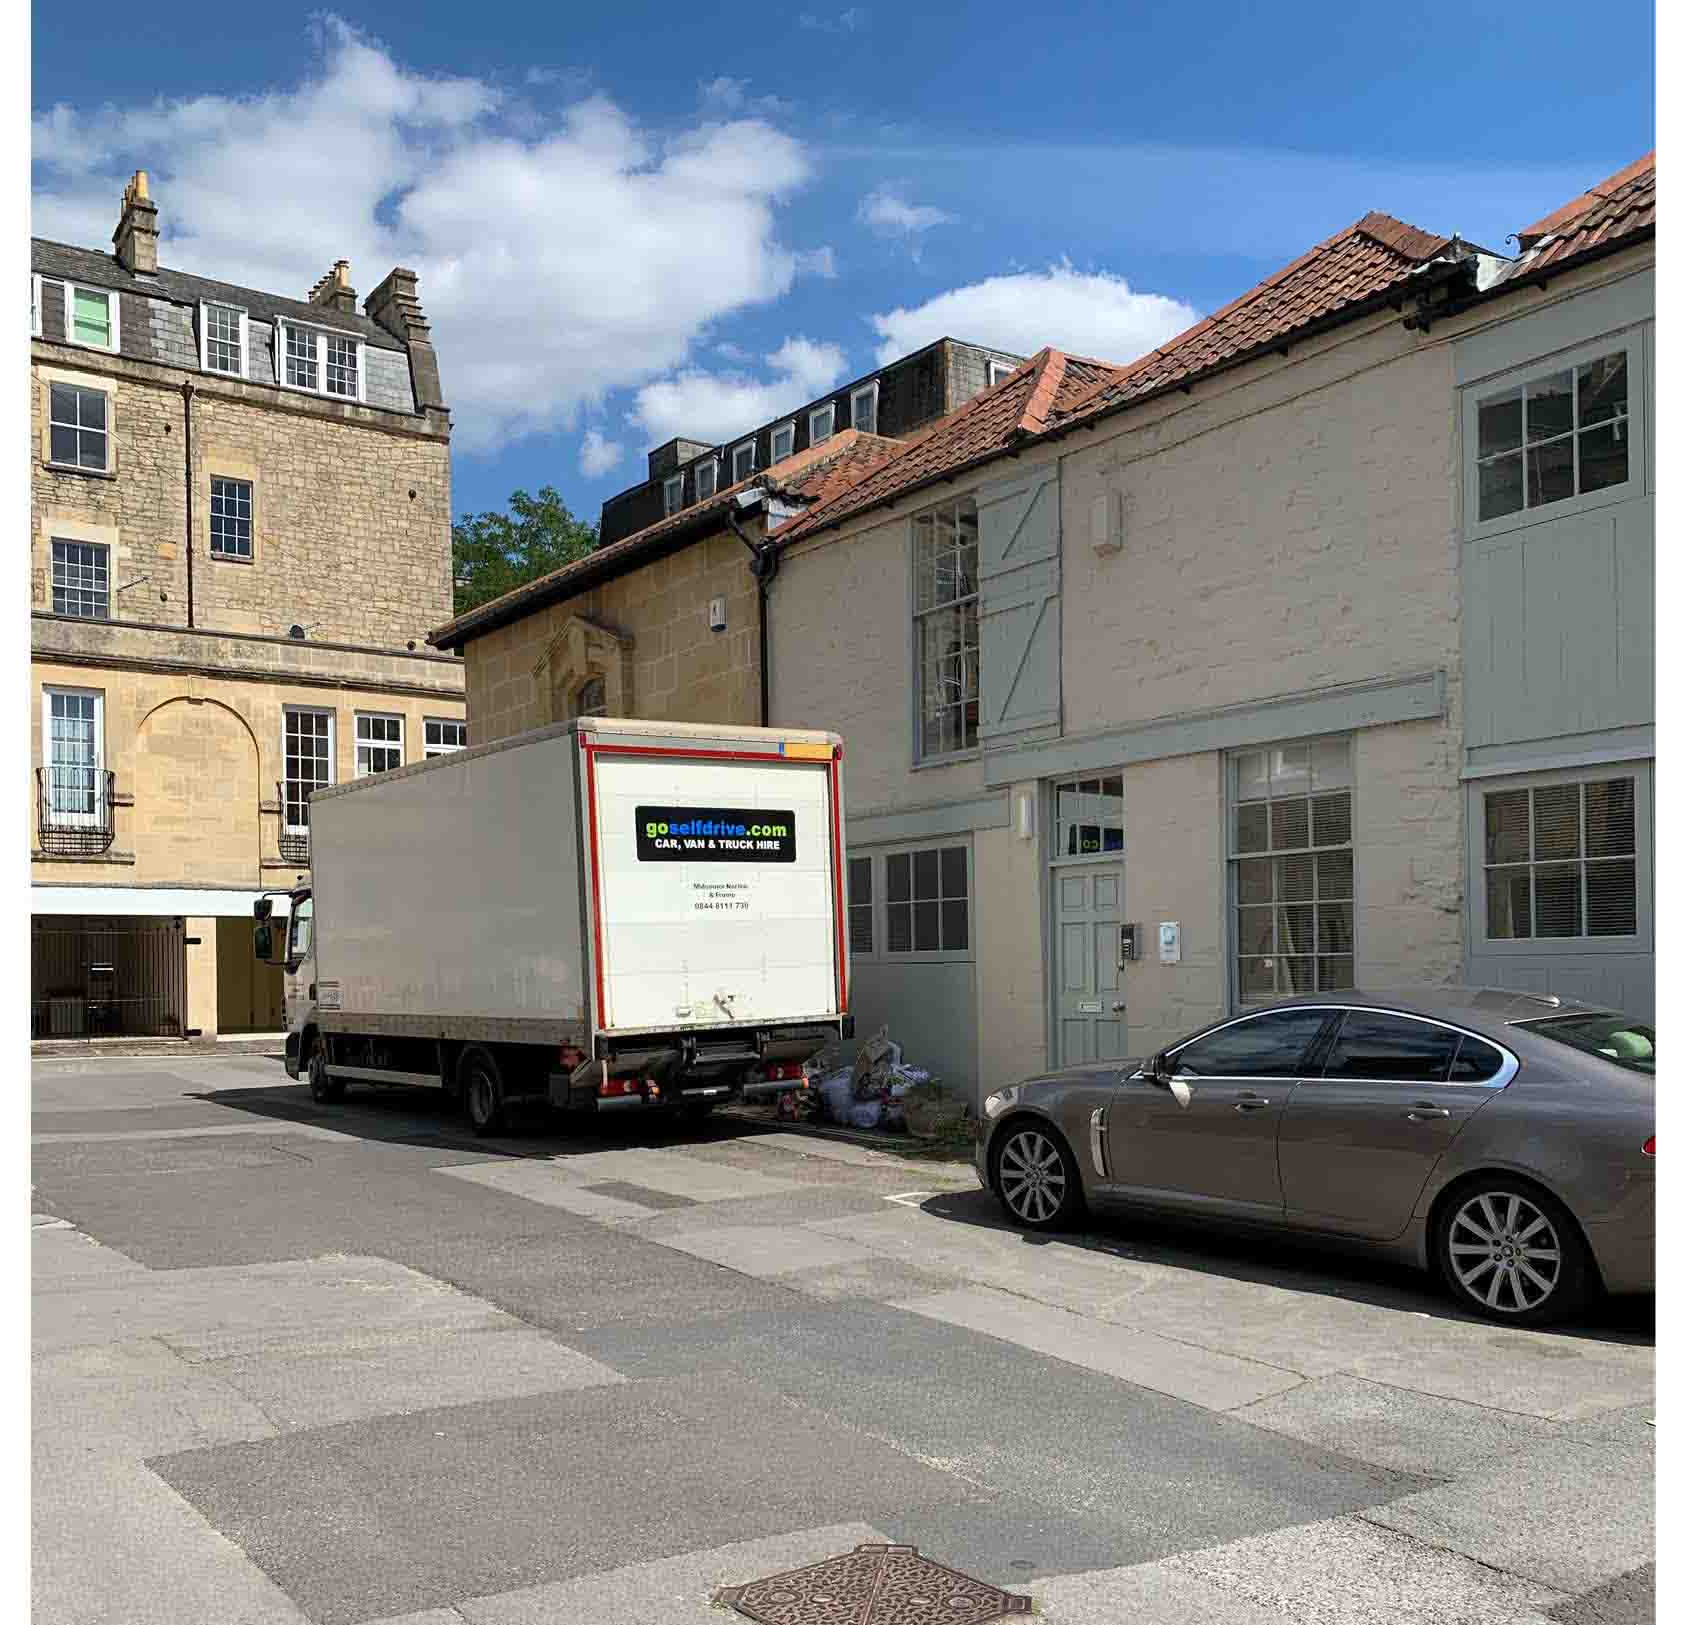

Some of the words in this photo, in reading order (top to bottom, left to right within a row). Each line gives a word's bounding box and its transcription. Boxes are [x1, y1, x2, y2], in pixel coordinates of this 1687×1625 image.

[646, 819, 787, 838] goselfdrive.com
[655, 838, 682, 850] CAR,
[683, 839, 705, 849] VAN
[708, 840, 716, 849] &
[718, 839, 754, 849] TRUCK
[756, 840, 780, 850] HIRE
